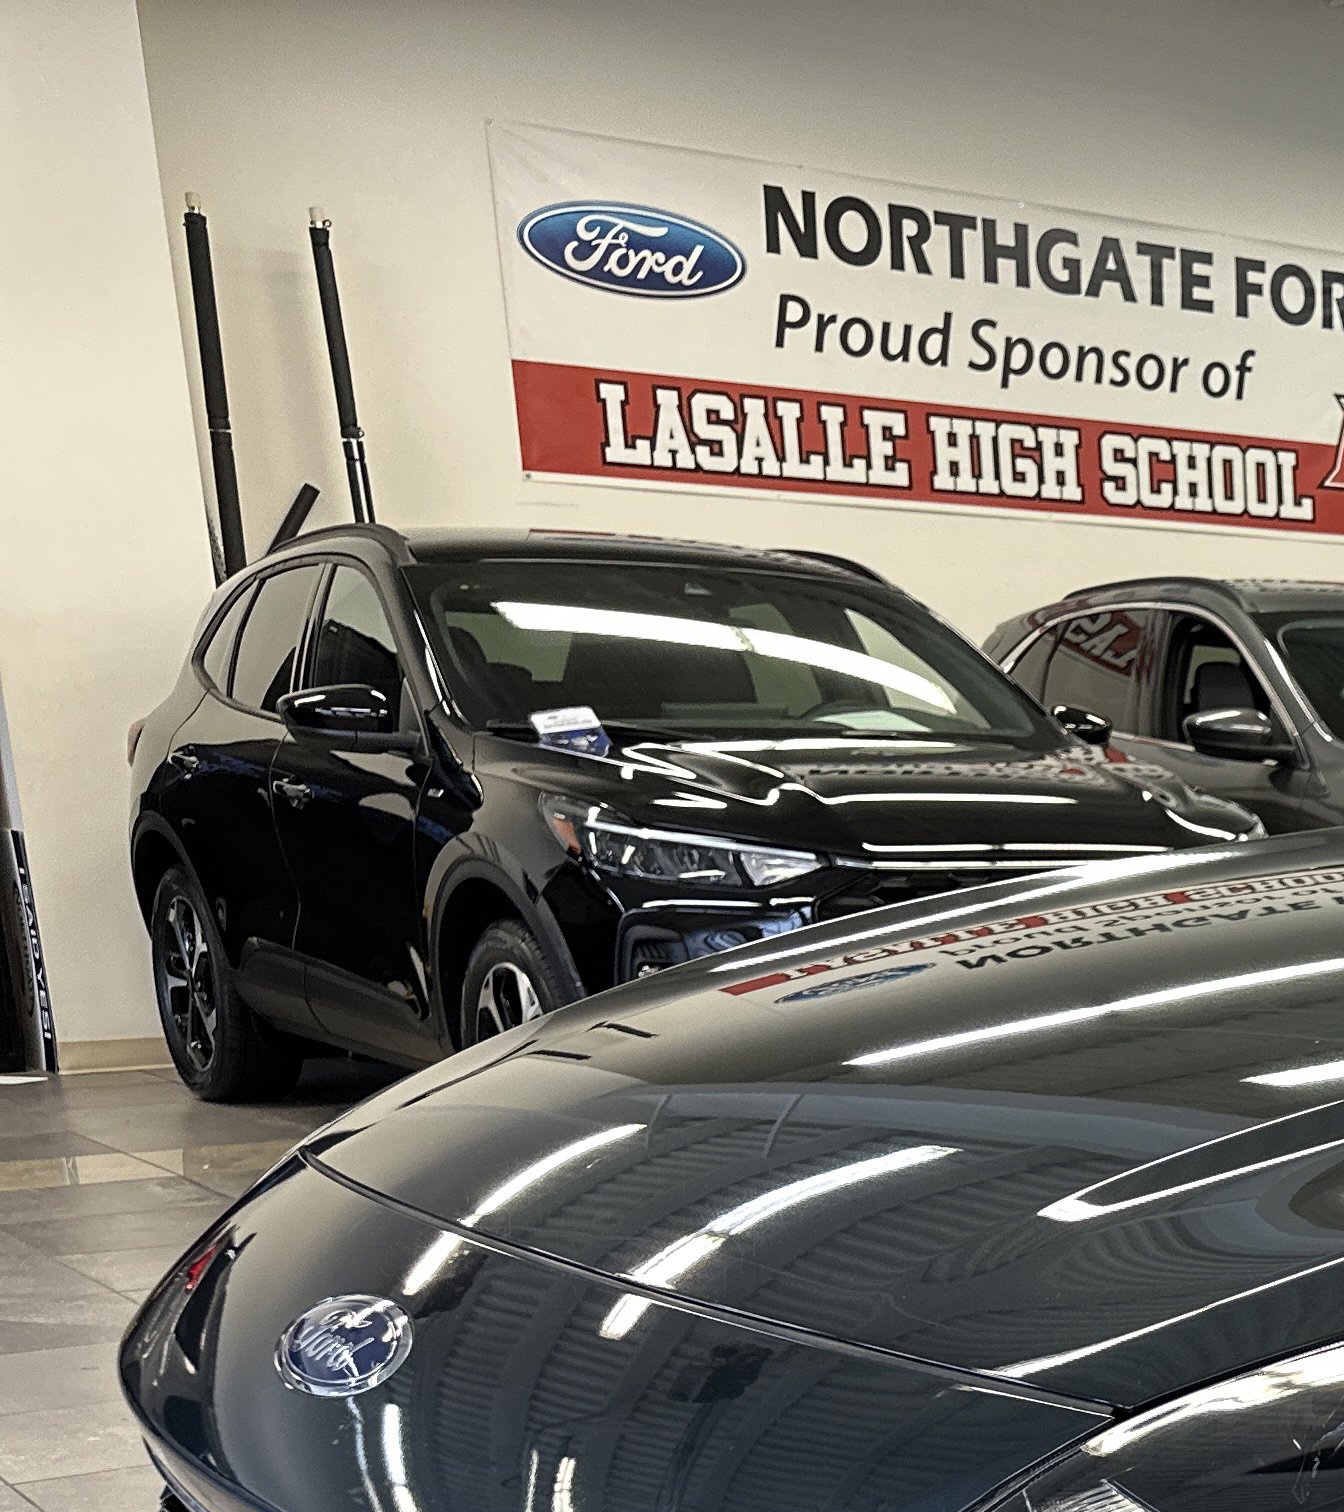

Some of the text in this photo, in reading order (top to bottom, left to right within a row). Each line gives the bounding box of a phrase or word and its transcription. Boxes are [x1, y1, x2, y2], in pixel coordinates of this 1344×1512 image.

[563, 214, 705, 287] Ford
[763, 184, 1214, 313] NORTHGATE
[775, 293, 1256, 400] Proud Sponsor of
[597, 380, 1315, 521] LASALLE HIGH SCHOOL
